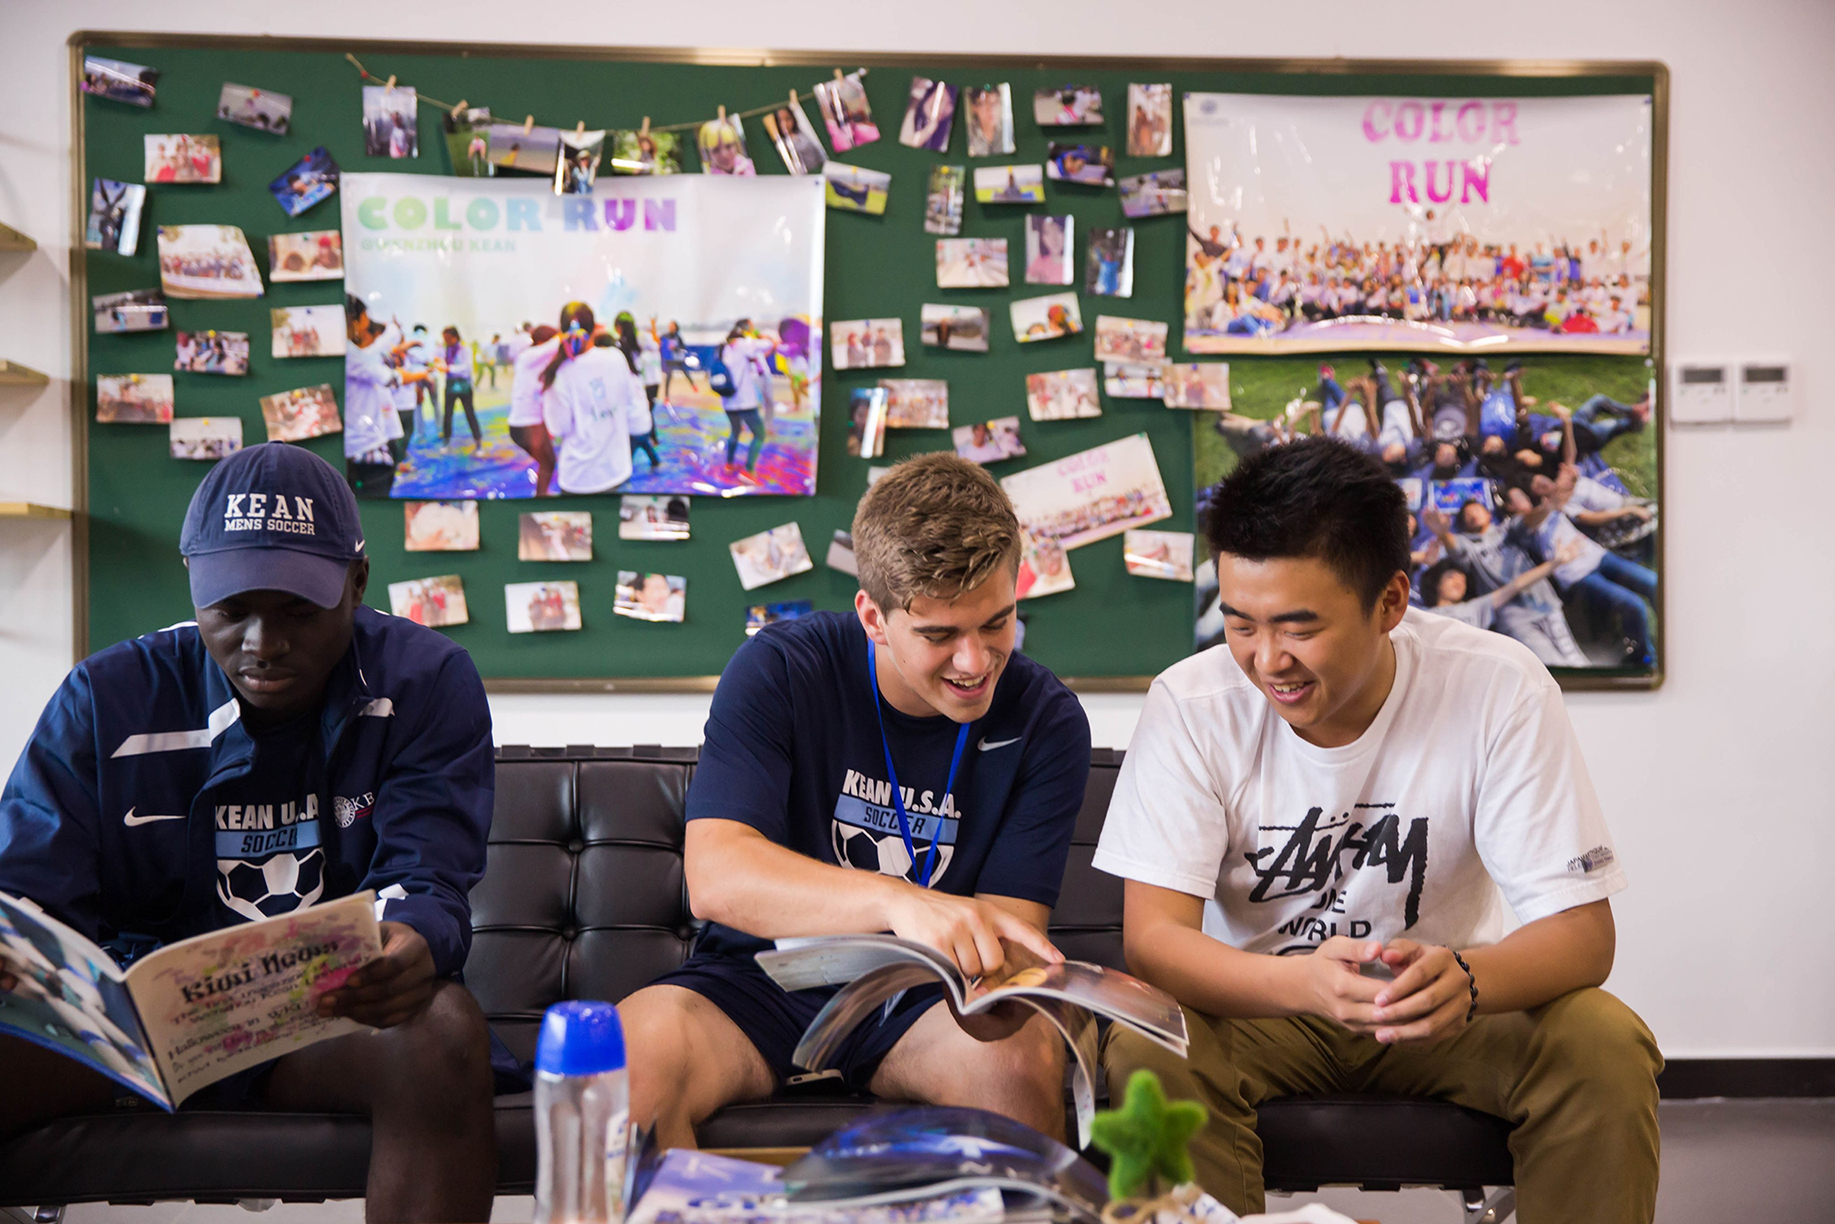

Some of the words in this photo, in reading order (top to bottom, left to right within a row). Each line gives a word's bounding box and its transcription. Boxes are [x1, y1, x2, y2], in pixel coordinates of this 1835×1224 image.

[1361, 99, 1521, 145] COLOR
[1388, 160, 1493, 204] RUN
[357, 196, 544, 232] COLOR
[562, 197, 677, 232] RUN
[469, 237, 516, 251] KEAN
[225, 493, 315, 522] KEAN
[224, 518, 263, 532] MENS
[266, 519, 316, 535] SOCCER
[842, 768, 892, 807] KEAN
[898, 785, 962, 819] U.S.A.
[215, 804, 274, 830] KEAN
